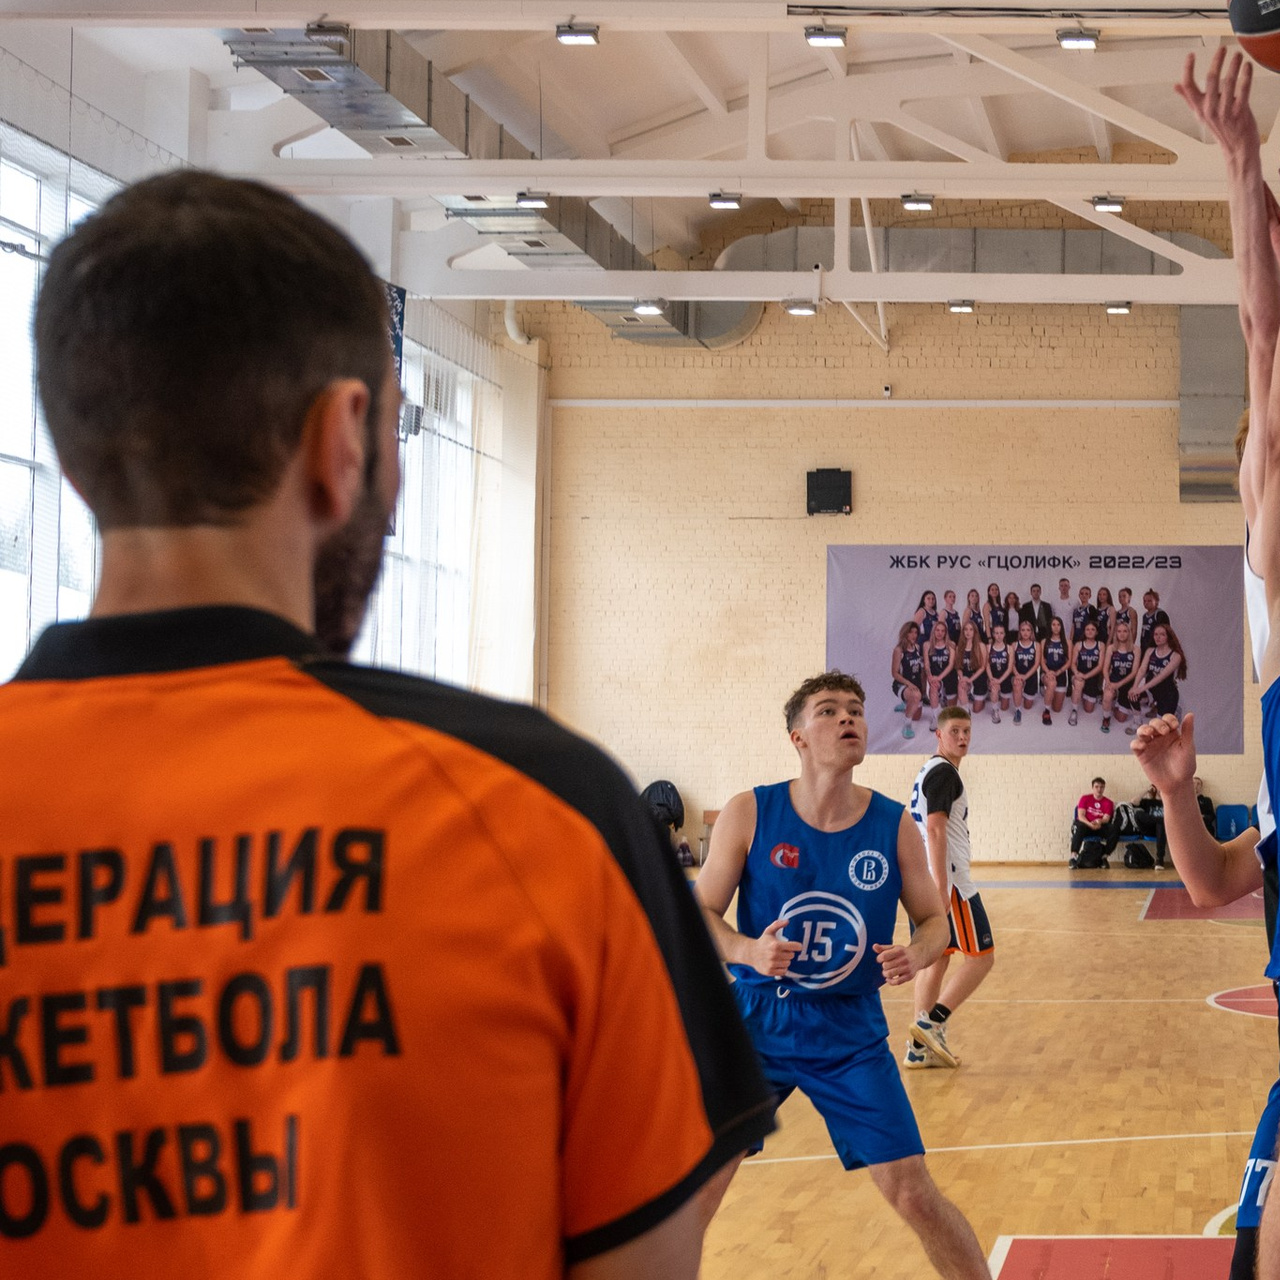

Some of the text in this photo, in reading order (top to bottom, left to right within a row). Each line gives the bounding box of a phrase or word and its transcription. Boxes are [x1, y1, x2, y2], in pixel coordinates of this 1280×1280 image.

[889, 555, 1182, 571] ЖБК РУС «ГЦОЛИФК» 2022/23
[0, 825, 387, 967] ЕРАЦИЯ
[797, 920, 837, 963] 15
